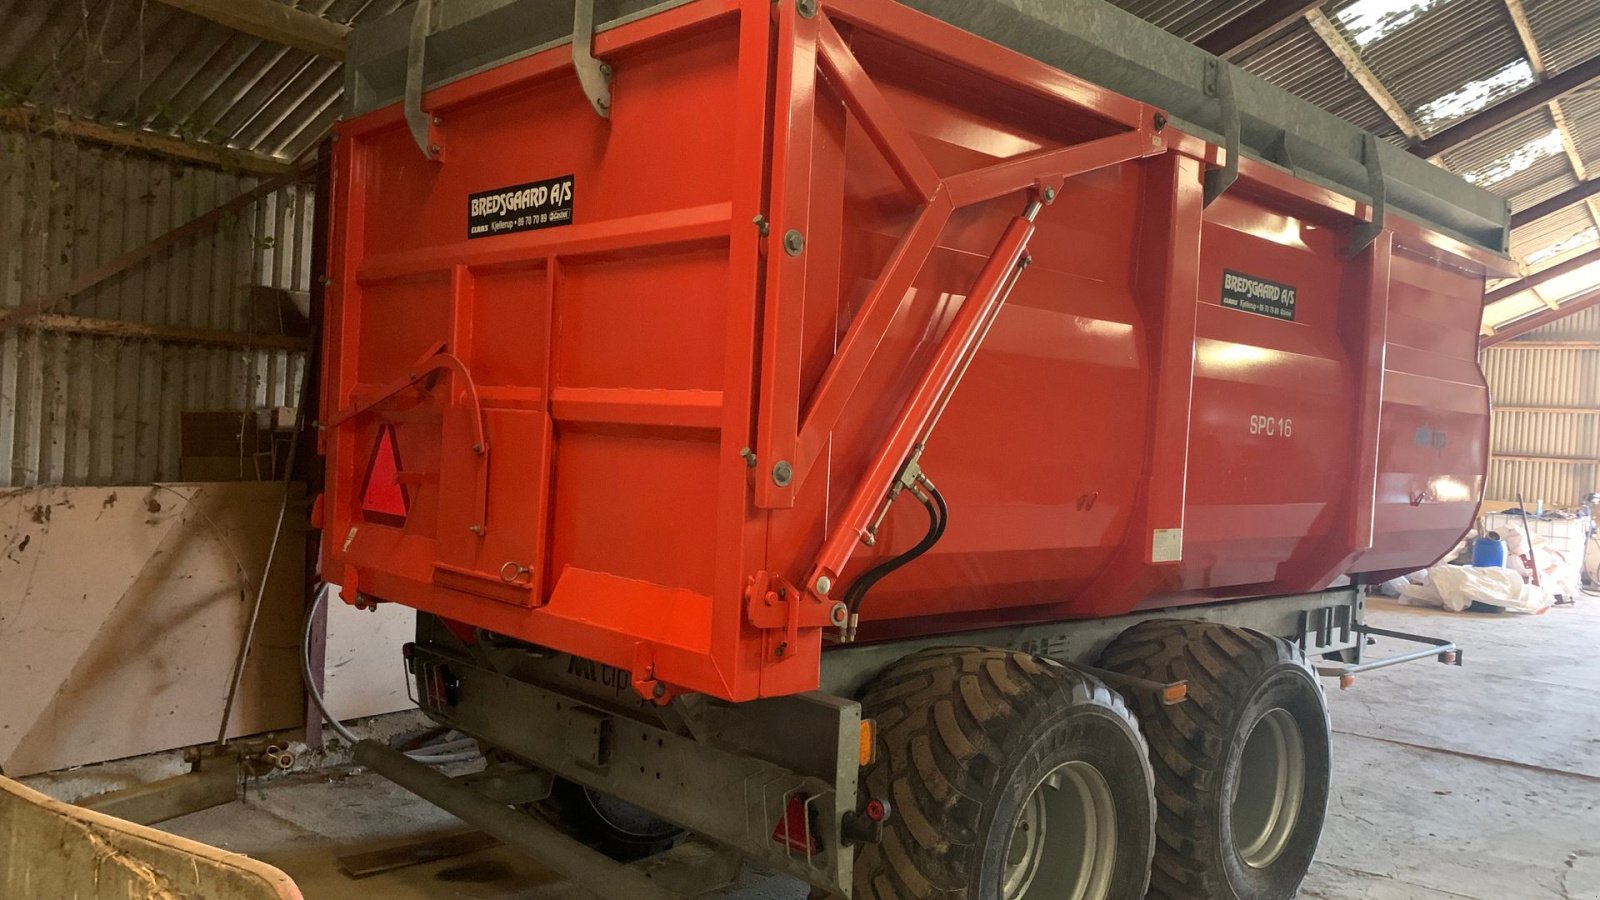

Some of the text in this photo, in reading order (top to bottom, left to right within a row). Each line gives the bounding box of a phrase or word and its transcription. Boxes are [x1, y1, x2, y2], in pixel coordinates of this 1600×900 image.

[471, 181, 572, 217] BREDSGAARD A/S
[491, 220, 514, 232] Kjellerup
[525, 215, 532, 225] 70
[532, 214, 540, 224] 70
[1224, 273, 1295, 307] BREDSGAARD A/S
[1250, 414, 1293, 438] SPC 16
